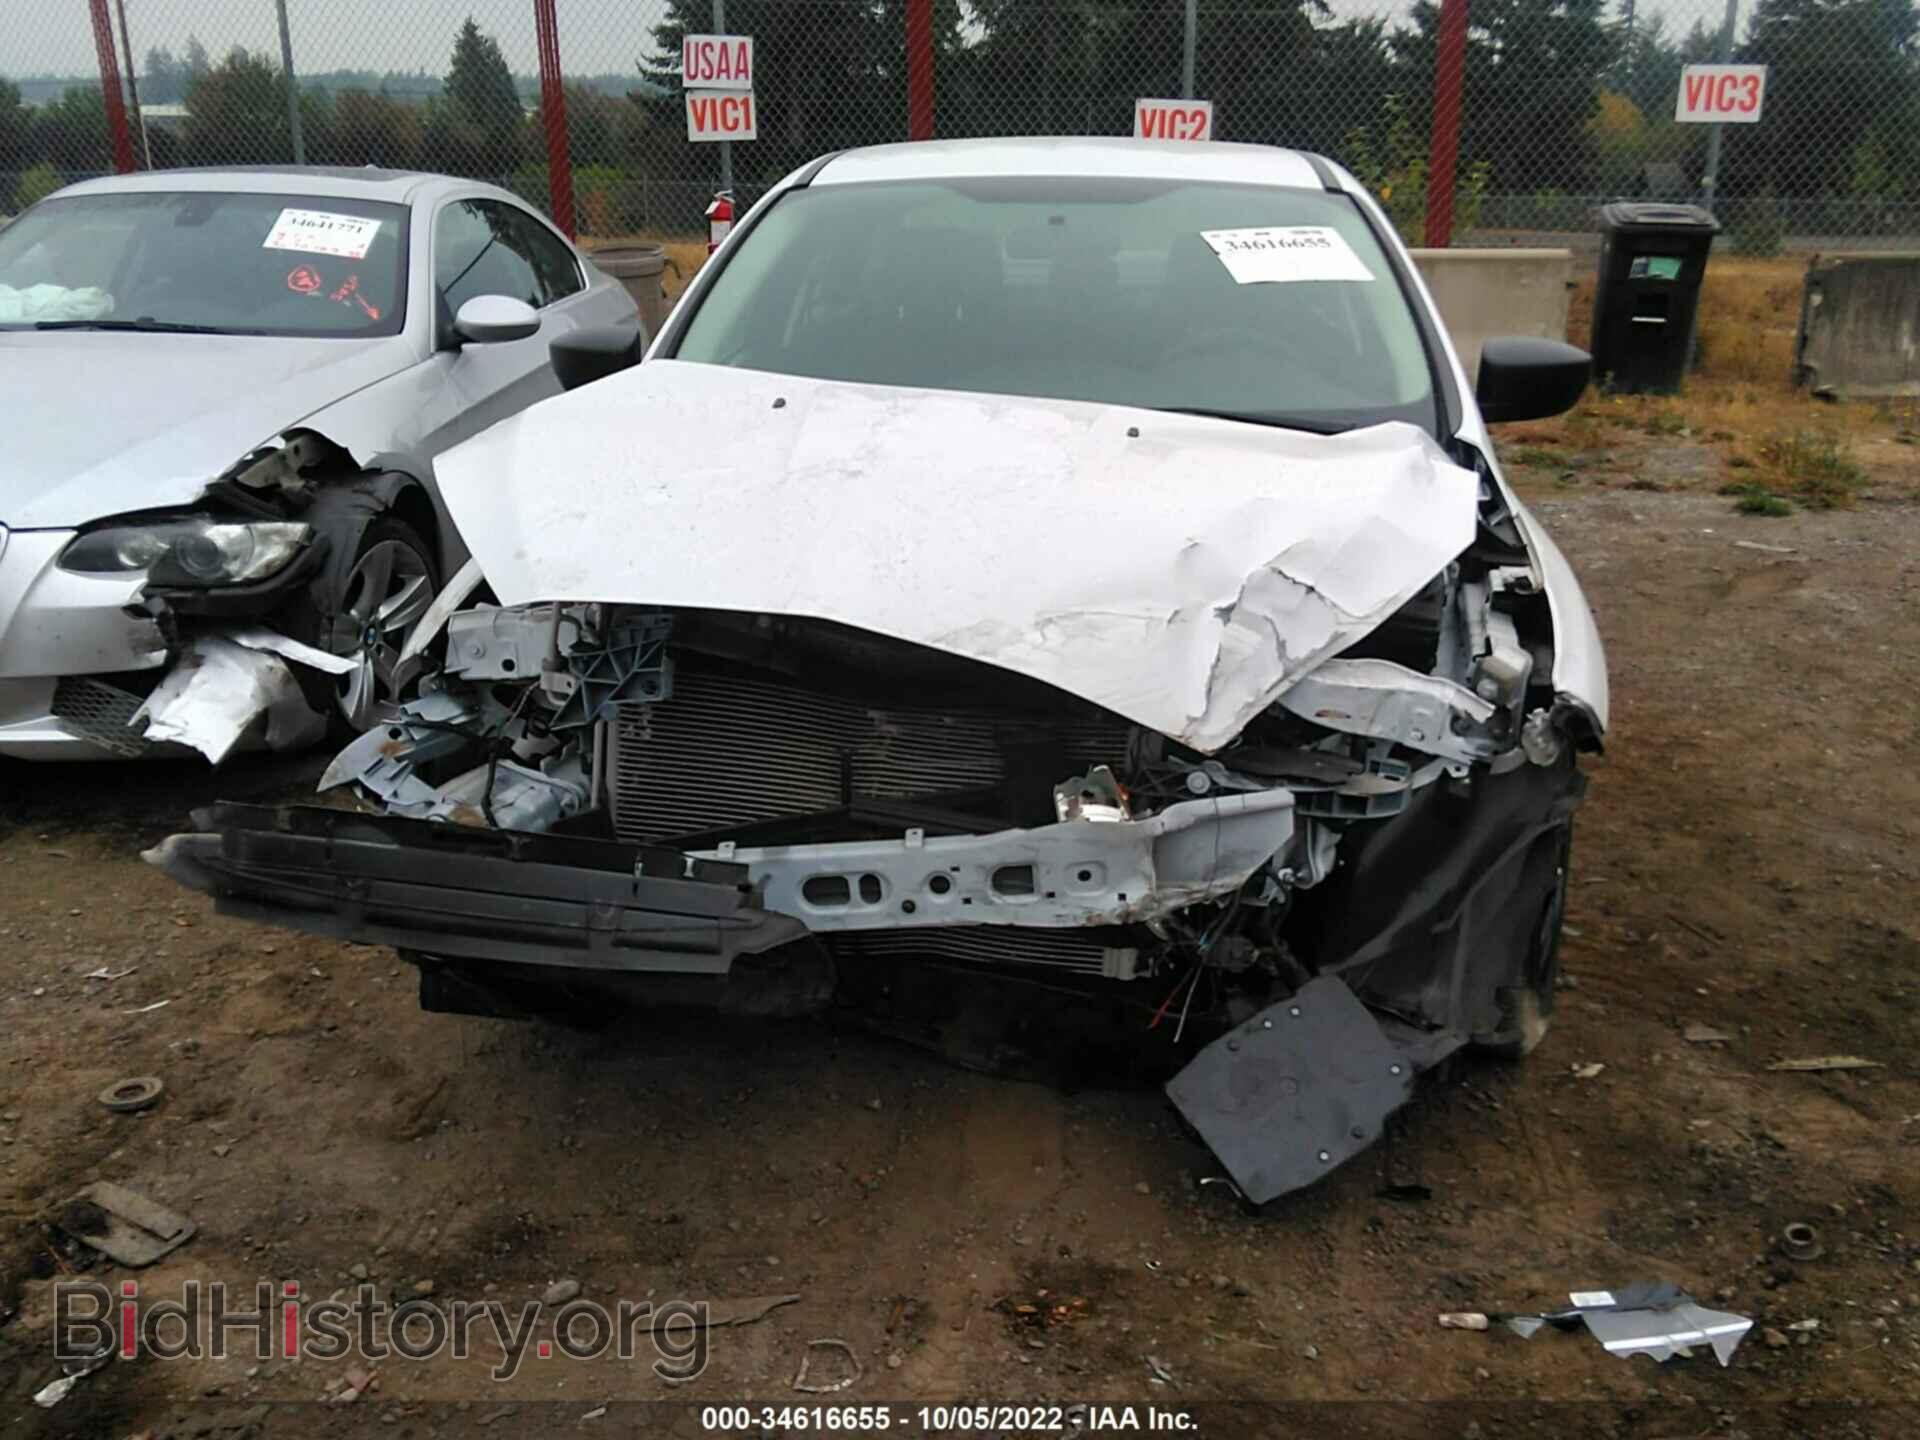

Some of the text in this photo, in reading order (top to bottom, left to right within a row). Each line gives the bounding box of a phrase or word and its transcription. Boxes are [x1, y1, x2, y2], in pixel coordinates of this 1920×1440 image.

[685, 41, 749, 80] USAA
[1685, 74, 1760, 112] VIC3
[690, 96, 752, 132] VIC1
[1139, 108, 1207, 141] VIC2
[1224, 237, 1331, 251] 34616655
